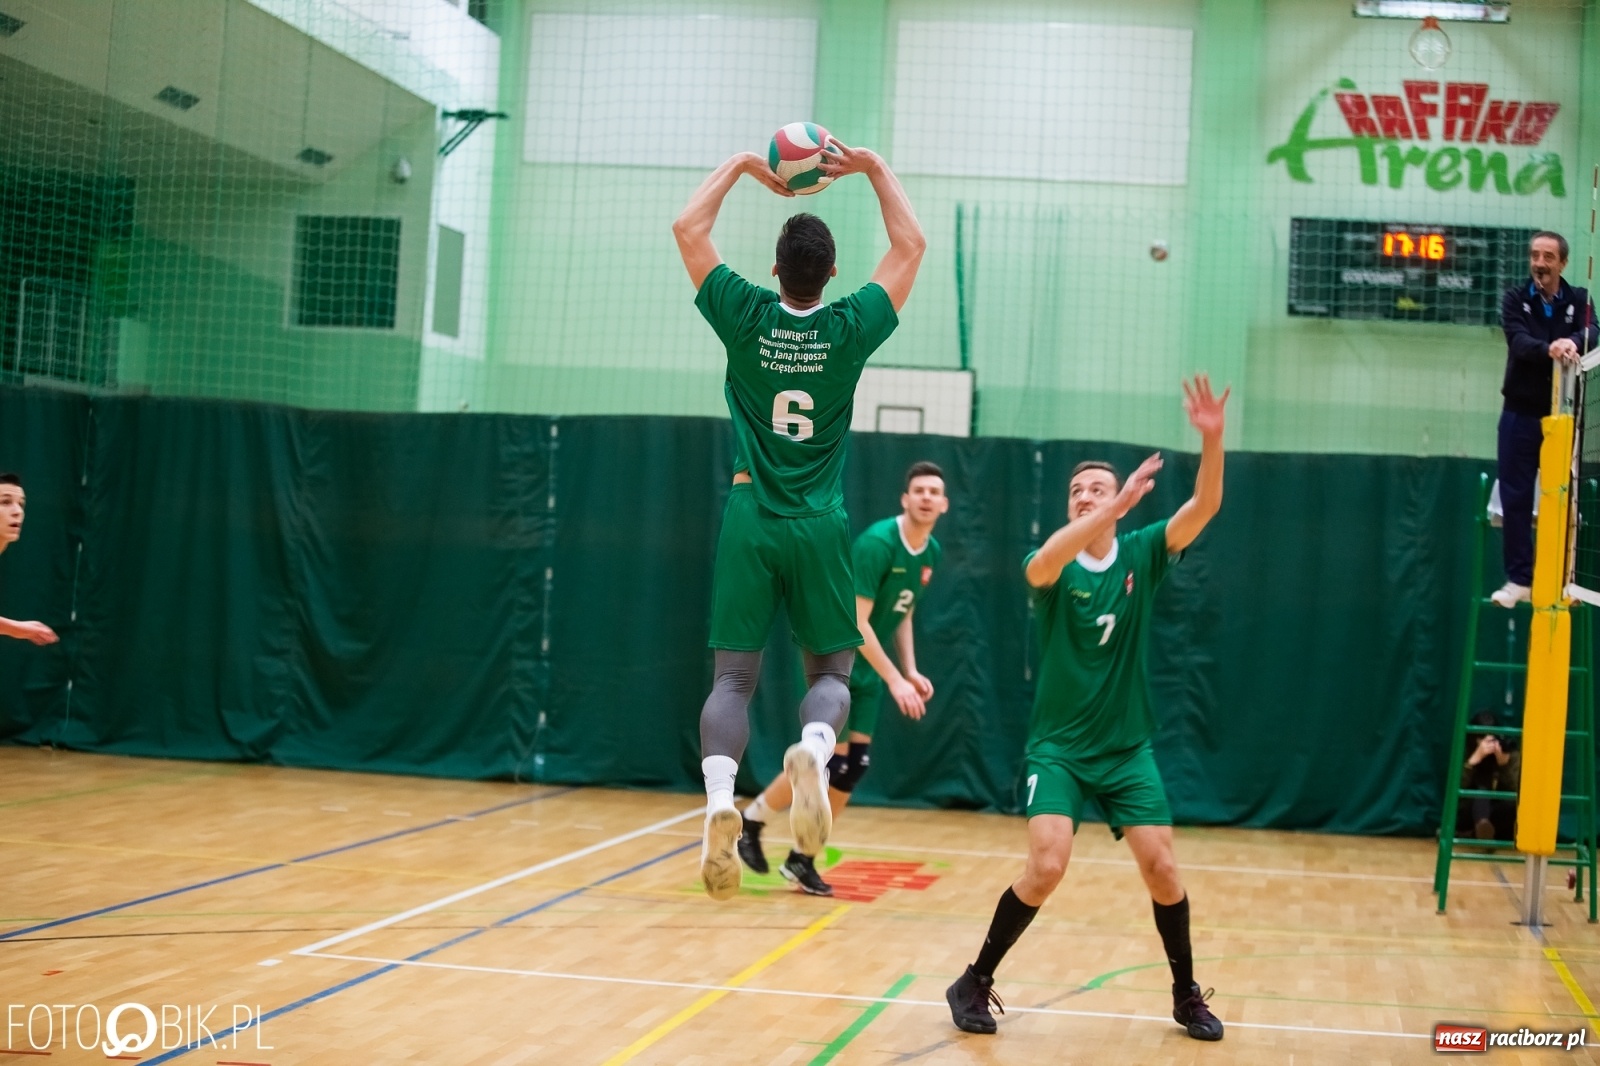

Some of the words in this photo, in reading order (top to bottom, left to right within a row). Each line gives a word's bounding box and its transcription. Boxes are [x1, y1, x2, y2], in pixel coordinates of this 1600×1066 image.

[1266, 77, 1566, 198] Arena
[759, 345, 772, 358] im.
[774, 350, 792, 361] Jana
[793, 352, 827, 363] Dugosza
[761, 360, 769, 368] w
[770, 361, 823, 374] Częstochowie
[772, 389, 814, 442] 6
[893, 589, 915, 613] 2
[1096, 613, 1116, 646] 7
[1026, 773, 1038, 807] 7
